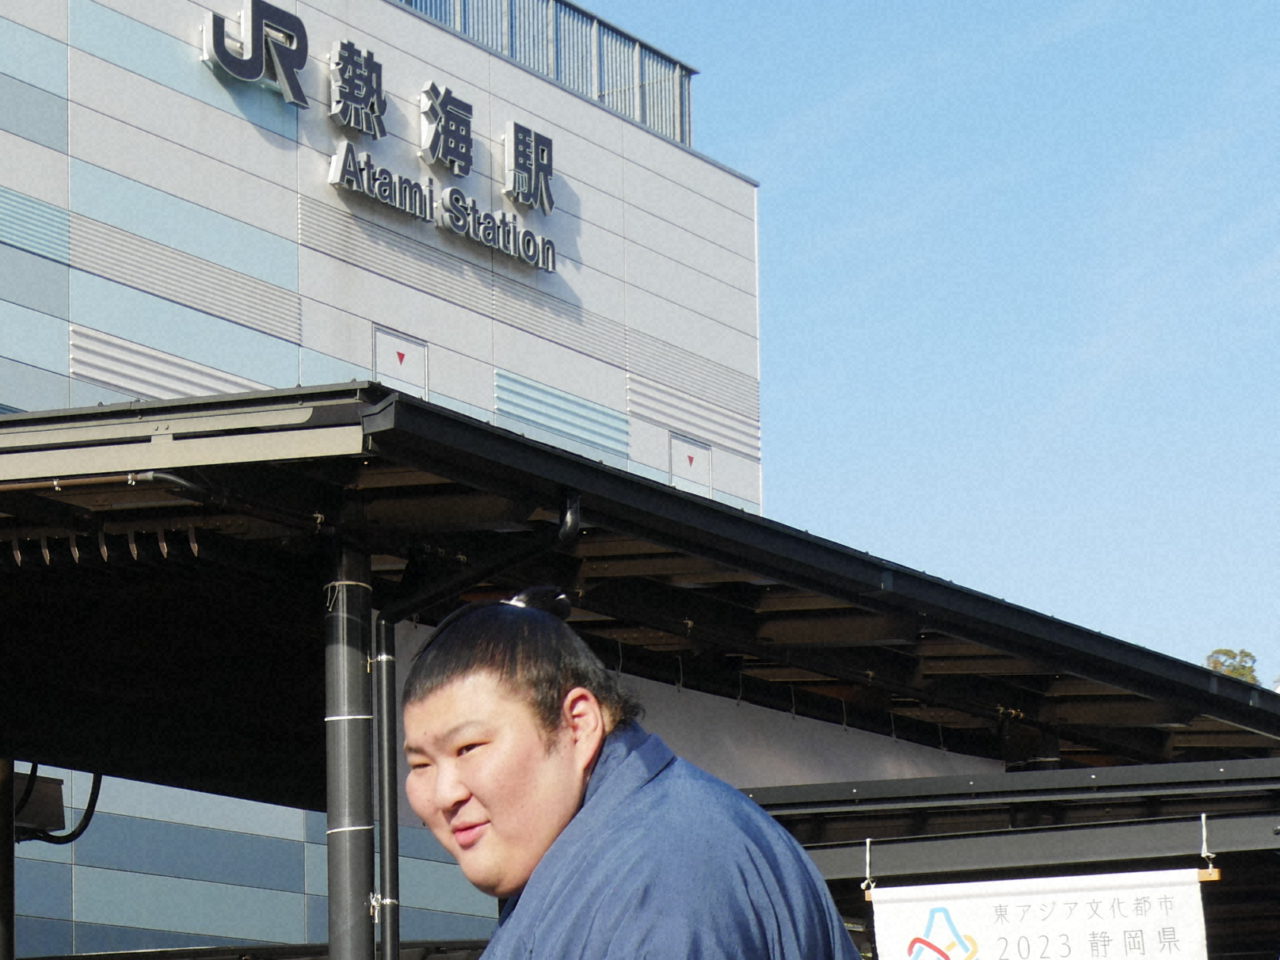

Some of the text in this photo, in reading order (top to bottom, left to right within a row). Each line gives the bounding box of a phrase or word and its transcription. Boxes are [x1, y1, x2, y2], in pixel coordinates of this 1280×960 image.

[204, 0, 310, 109] JR
[329, 39, 556, 217] 熱海駅
[328, 140, 557, 273] Atami Station
[992, 894, 1175, 925] 東アジア文化都市
[997, 926, 1181, 960] 2023 静岡県
